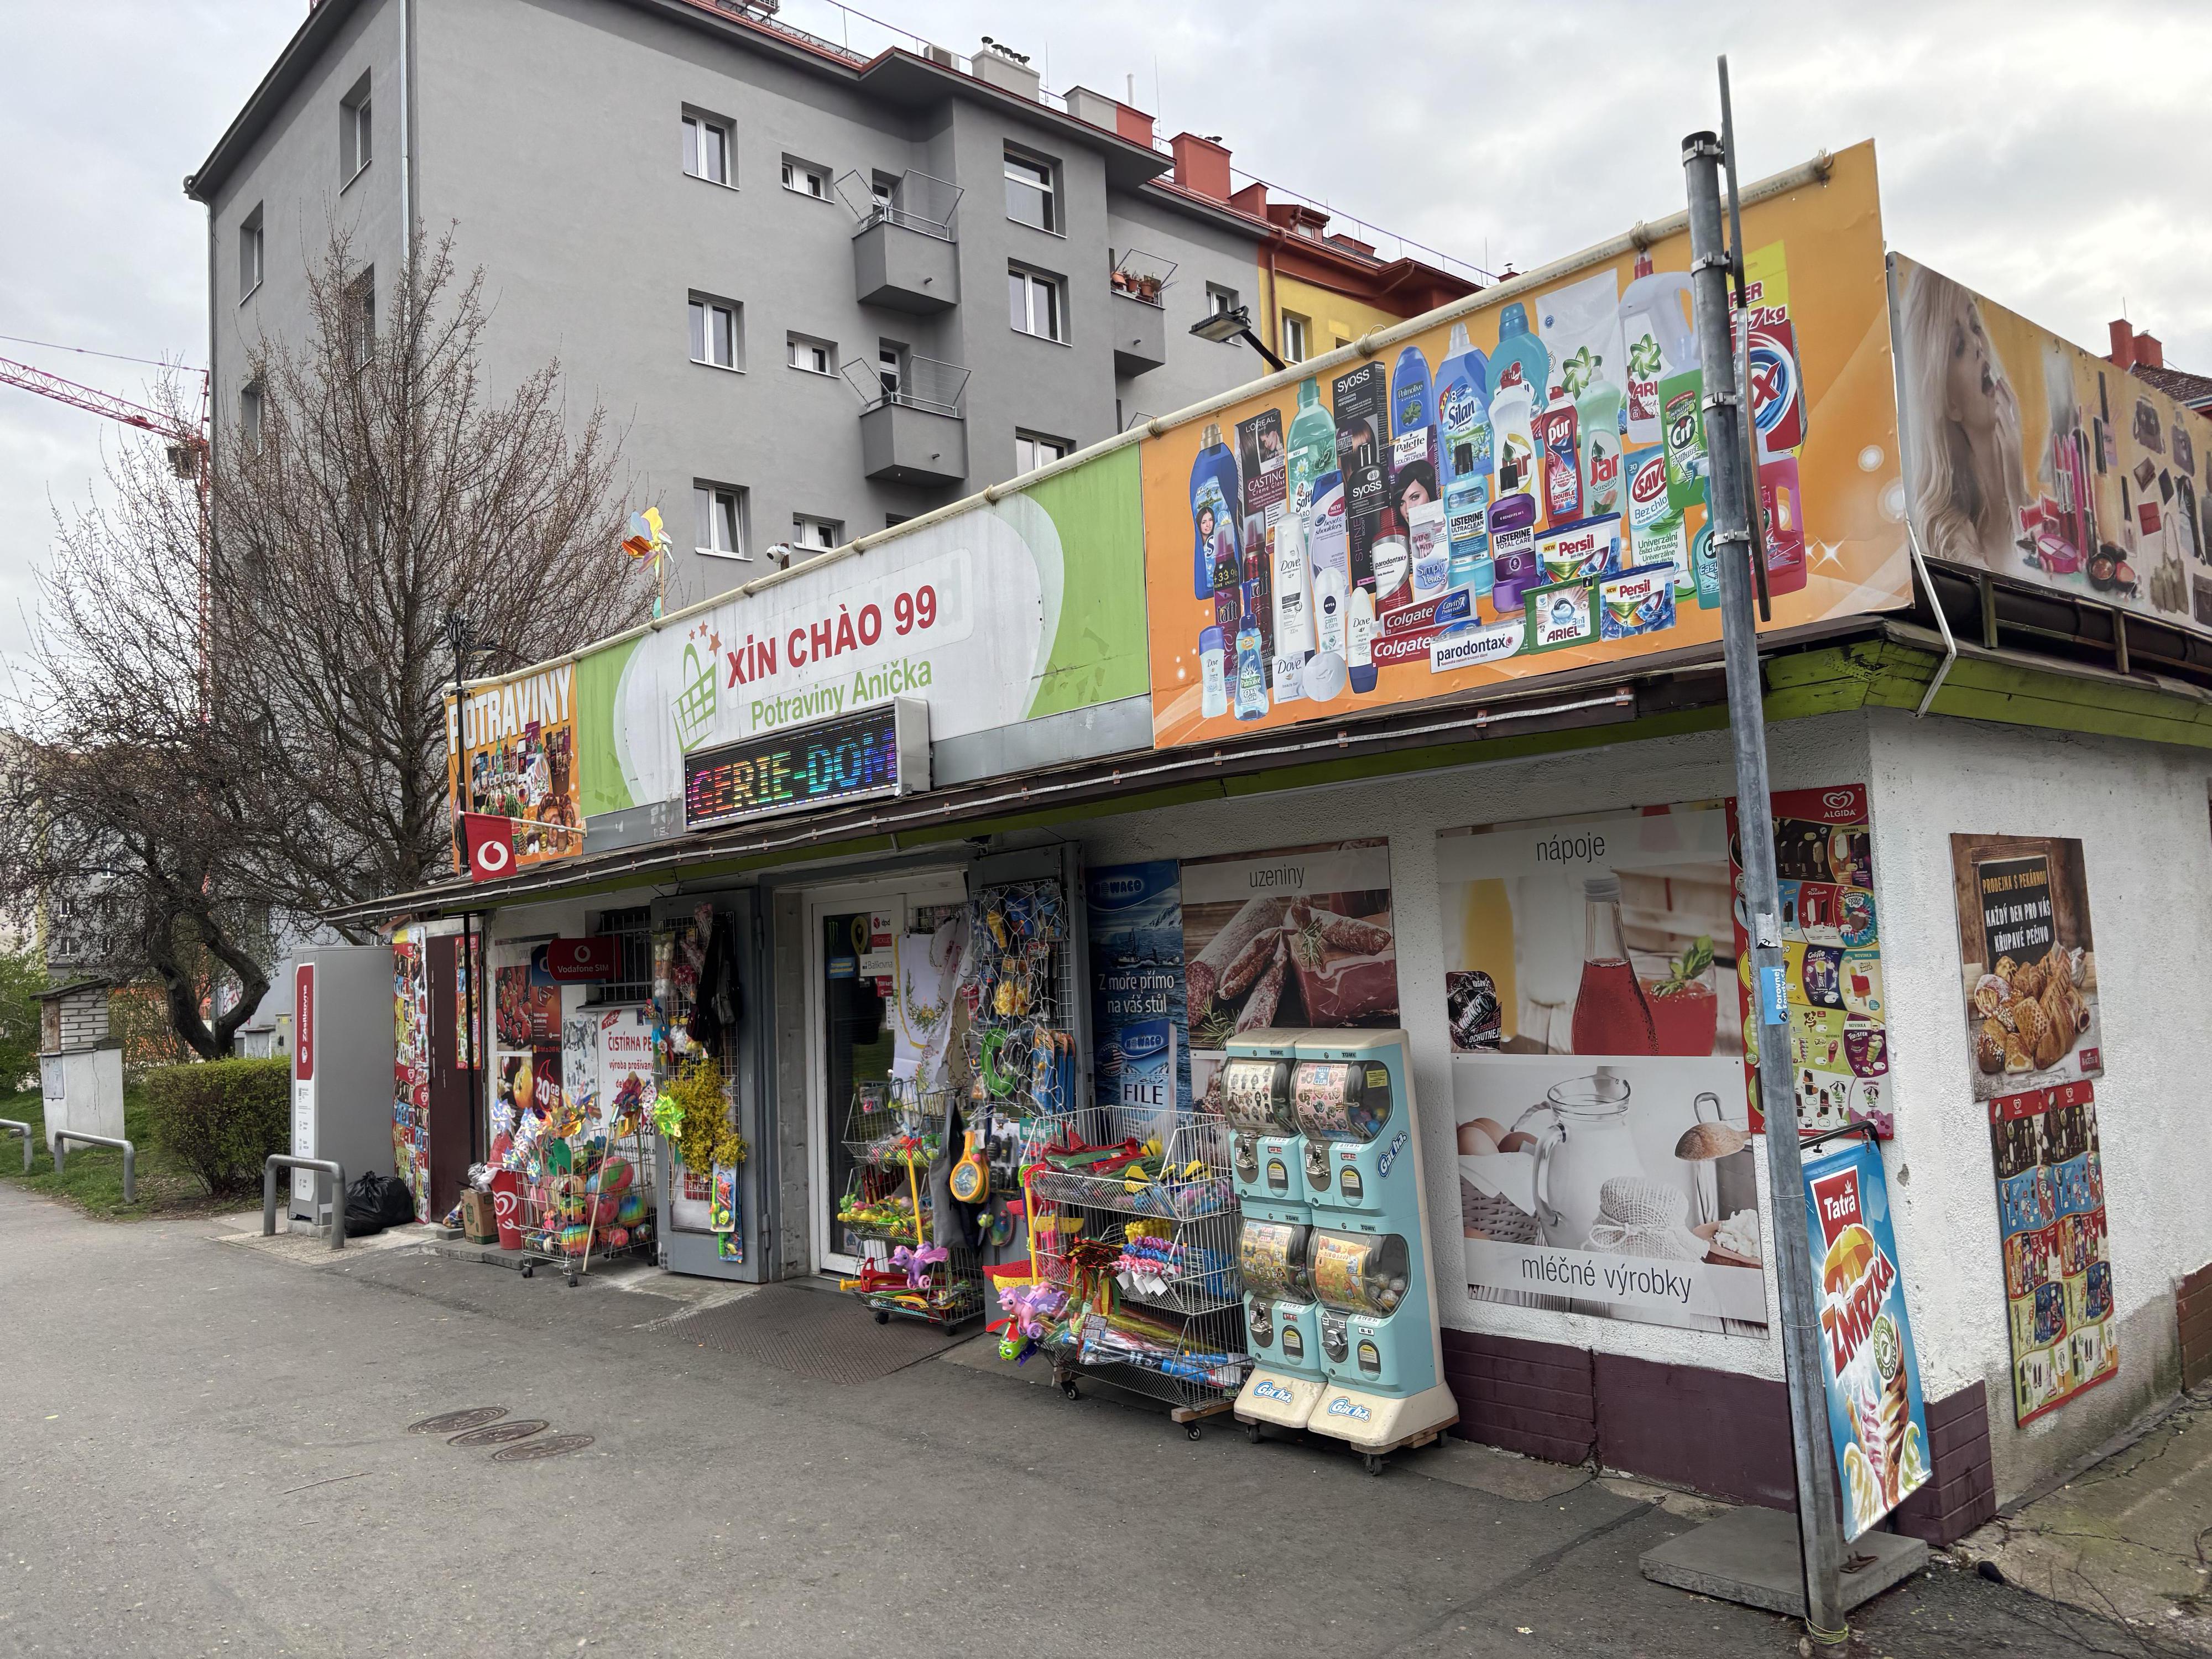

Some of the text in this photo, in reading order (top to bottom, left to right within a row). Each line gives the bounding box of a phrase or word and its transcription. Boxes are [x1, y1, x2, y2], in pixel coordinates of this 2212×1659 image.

[1338, 369, 1370, 393] syoss
[1448, 400, 1475, 430] Silan
[1548, 419, 1571, 446] pur
[1672, 418, 1692, 447] Cif
[1396, 437, 1425, 452] Palette
[1248, 469, 1286, 492] CASTING
[1352, 480, 1383, 499] syoss
[1553, 489, 1575, 501] DOUBLE
[1330, 503, 1342, 511] NEW
[1635, 508, 1650, 519] Bez
[1451, 510, 1484, 526] LISTERINE
[1451, 520, 1484, 533] ULTRACLEAN
[1353, 517, 1364, 562] SHINE
[1495, 528, 1531, 545] LISTERINE
[1496, 536, 1532, 550] TOTAL CARE
[1558, 534, 1594, 557] Persil
[1638, 531, 1678, 549] Univerzální
[1375, 555, 1405, 570] parodontax
[1416, 559, 1446, 577] Simply
[1421, 574, 1442, 587] Venus
[1619, 578, 1651, 598] Persil
[1217, 600, 1238, 624] taft
[1353, 617, 1371, 628] Dove
[1386, 606, 1434, 628] Colgate
[787, 604, 882, 668] CHÀO
[894, 584, 937, 636] 99
[1546, 625, 1582, 643] ARIEL
[1374, 635, 1431, 658] Colgate
[1436, 634, 1506, 666] parodontax
[1277, 659, 1302, 674] Dove
[751, 657, 933, 731] Potraviny Anička
[448, 663, 572, 755] POTRAVINY
[1823, 809, 1856, 818] ALGIDA
[1536, 831, 1606, 865] nápoje
[1249, 863, 1305, 889] uzeniny
[1983, 875, 2013, 895] PRODEJNA
[2013, 875, 2018, 890] S
[1985, 895, 2052, 928] KAŽDÝ DEN PRO VÁS
[1994, 923, 2049, 954] KŘUPAVÉ PEČIVO
[557, 963, 610, 973] Vodafone SIM
[1108, 971, 1138, 990] moře
[1141, 969, 1175, 994] přímo
[1107, 993, 1167, 1014] na váš stůl
[608, 1030, 641, 1052] ČISTÍRNA
[1468, 1027, 1501, 1043] OCHUTNEJ!
[609, 1058, 627, 1071] výroba
[536, 1076, 560, 1105] 20 GB
[1824, 1191, 1856, 1221] Tatra
[1521, 1254, 1692, 1304] mléčné výrobky
